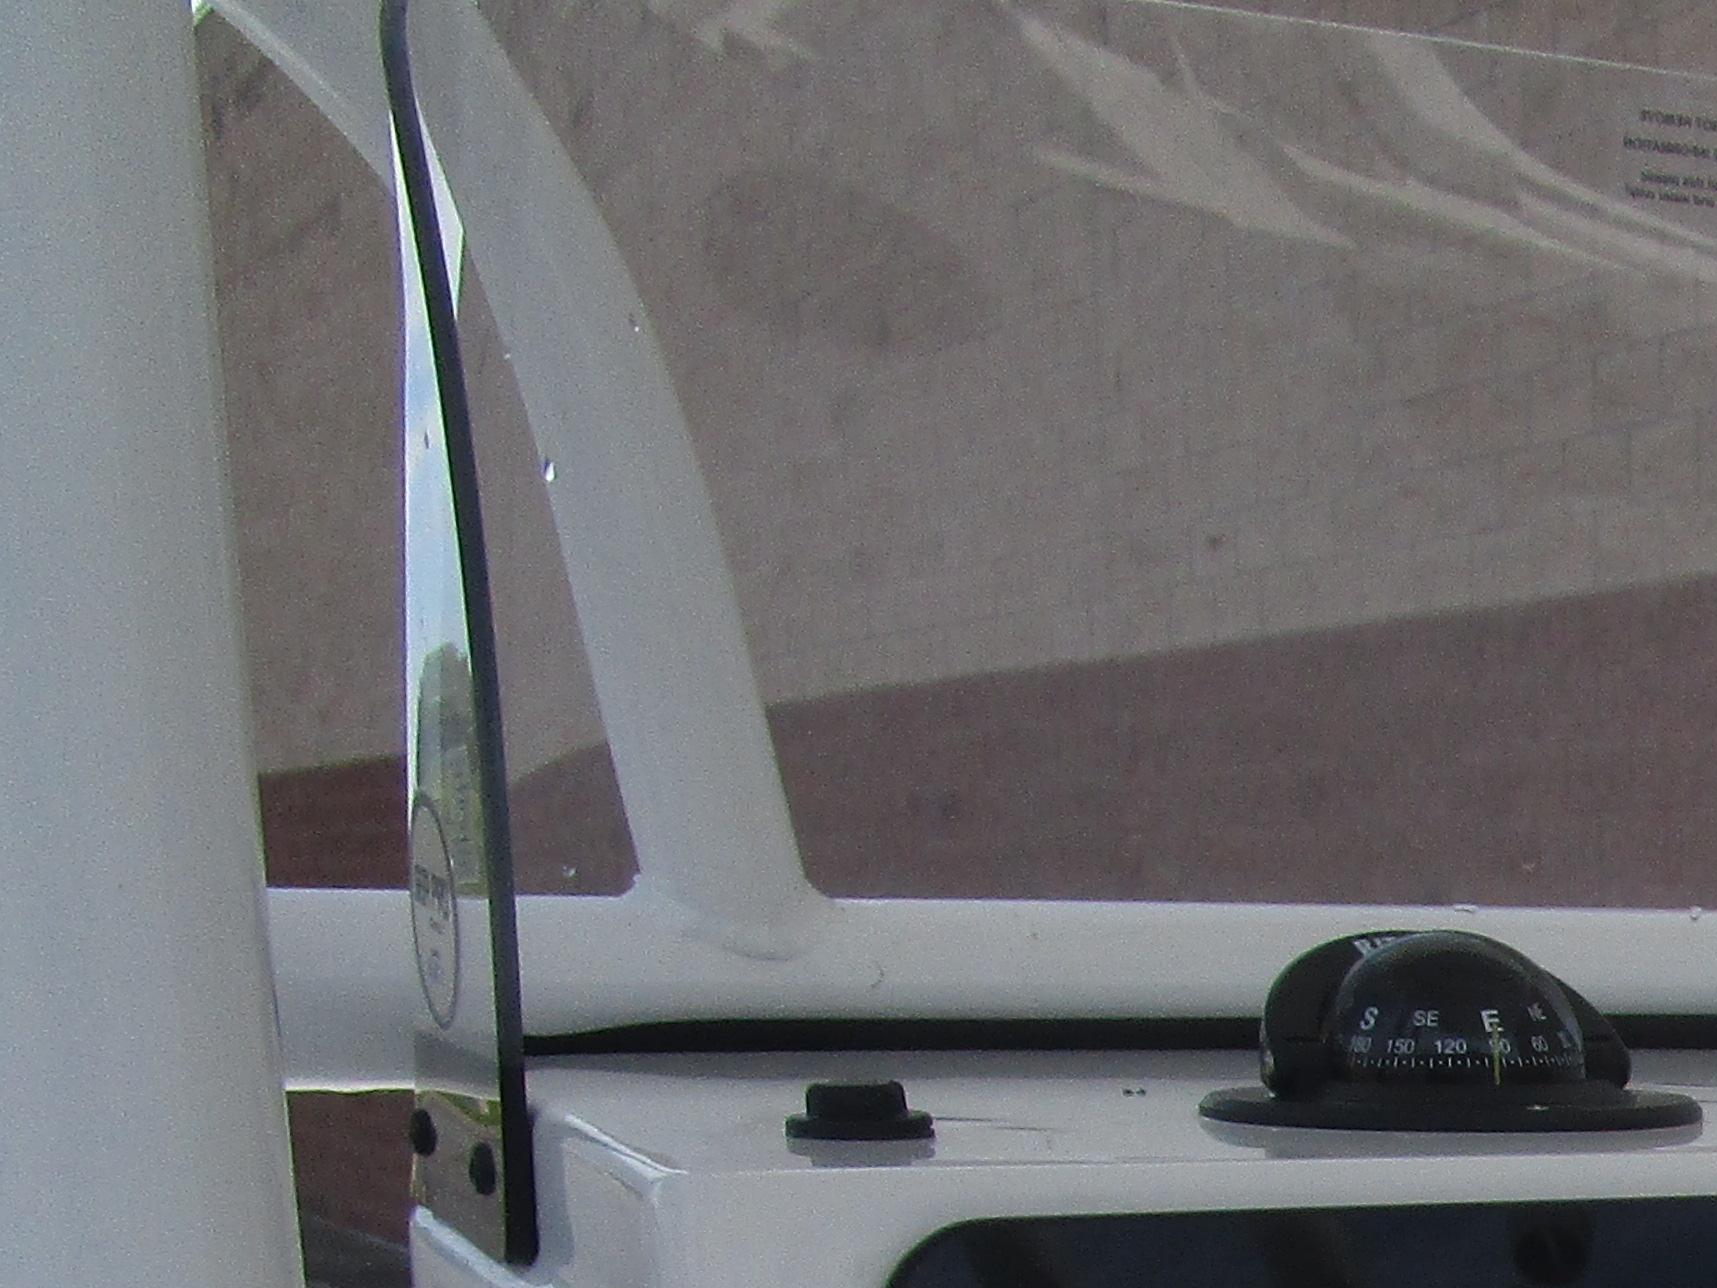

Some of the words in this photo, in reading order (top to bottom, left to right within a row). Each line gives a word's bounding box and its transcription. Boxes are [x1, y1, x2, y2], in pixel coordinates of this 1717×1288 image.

[1359, 1007, 1379, 1031] S
[1413, 1009, 1440, 1027] SE
[1480, 1009, 1504, 1033] E
[1386, 1039, 1416, 1055] 150
[1434, 1039, 1468, 1054] 120
